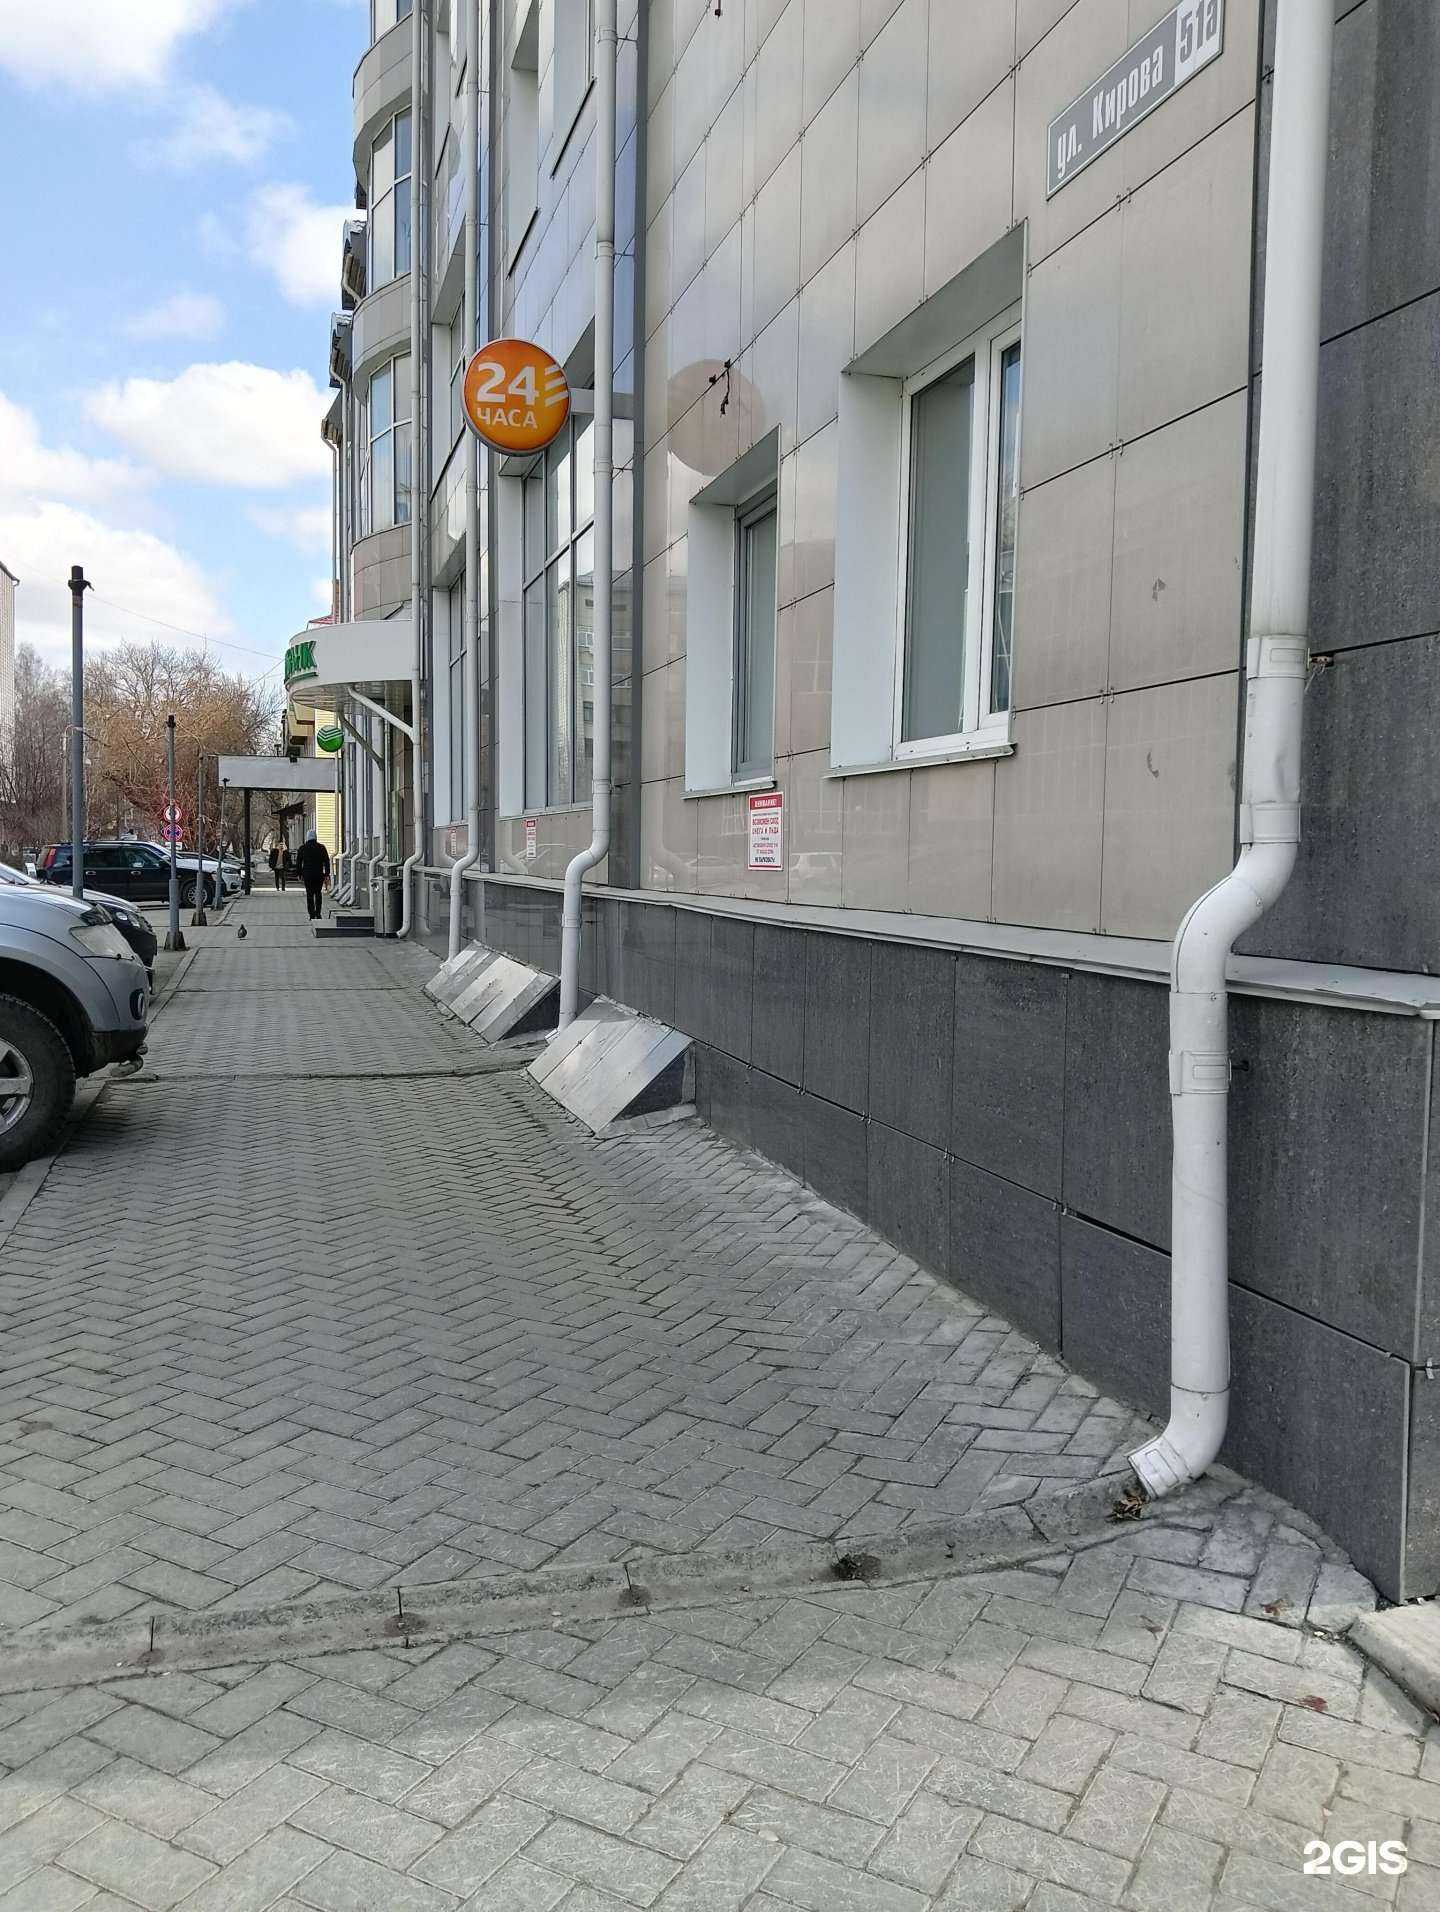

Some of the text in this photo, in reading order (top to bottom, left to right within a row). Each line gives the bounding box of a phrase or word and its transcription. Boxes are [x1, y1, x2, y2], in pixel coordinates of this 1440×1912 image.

[1057, 124, 1082, 179] ул.
[1092, 45, 1164, 140] Кирова
[477, 362, 540, 406] 24
[476, 407, 538, 429] ЧАСА
[285, 640, 319, 682] АНК
